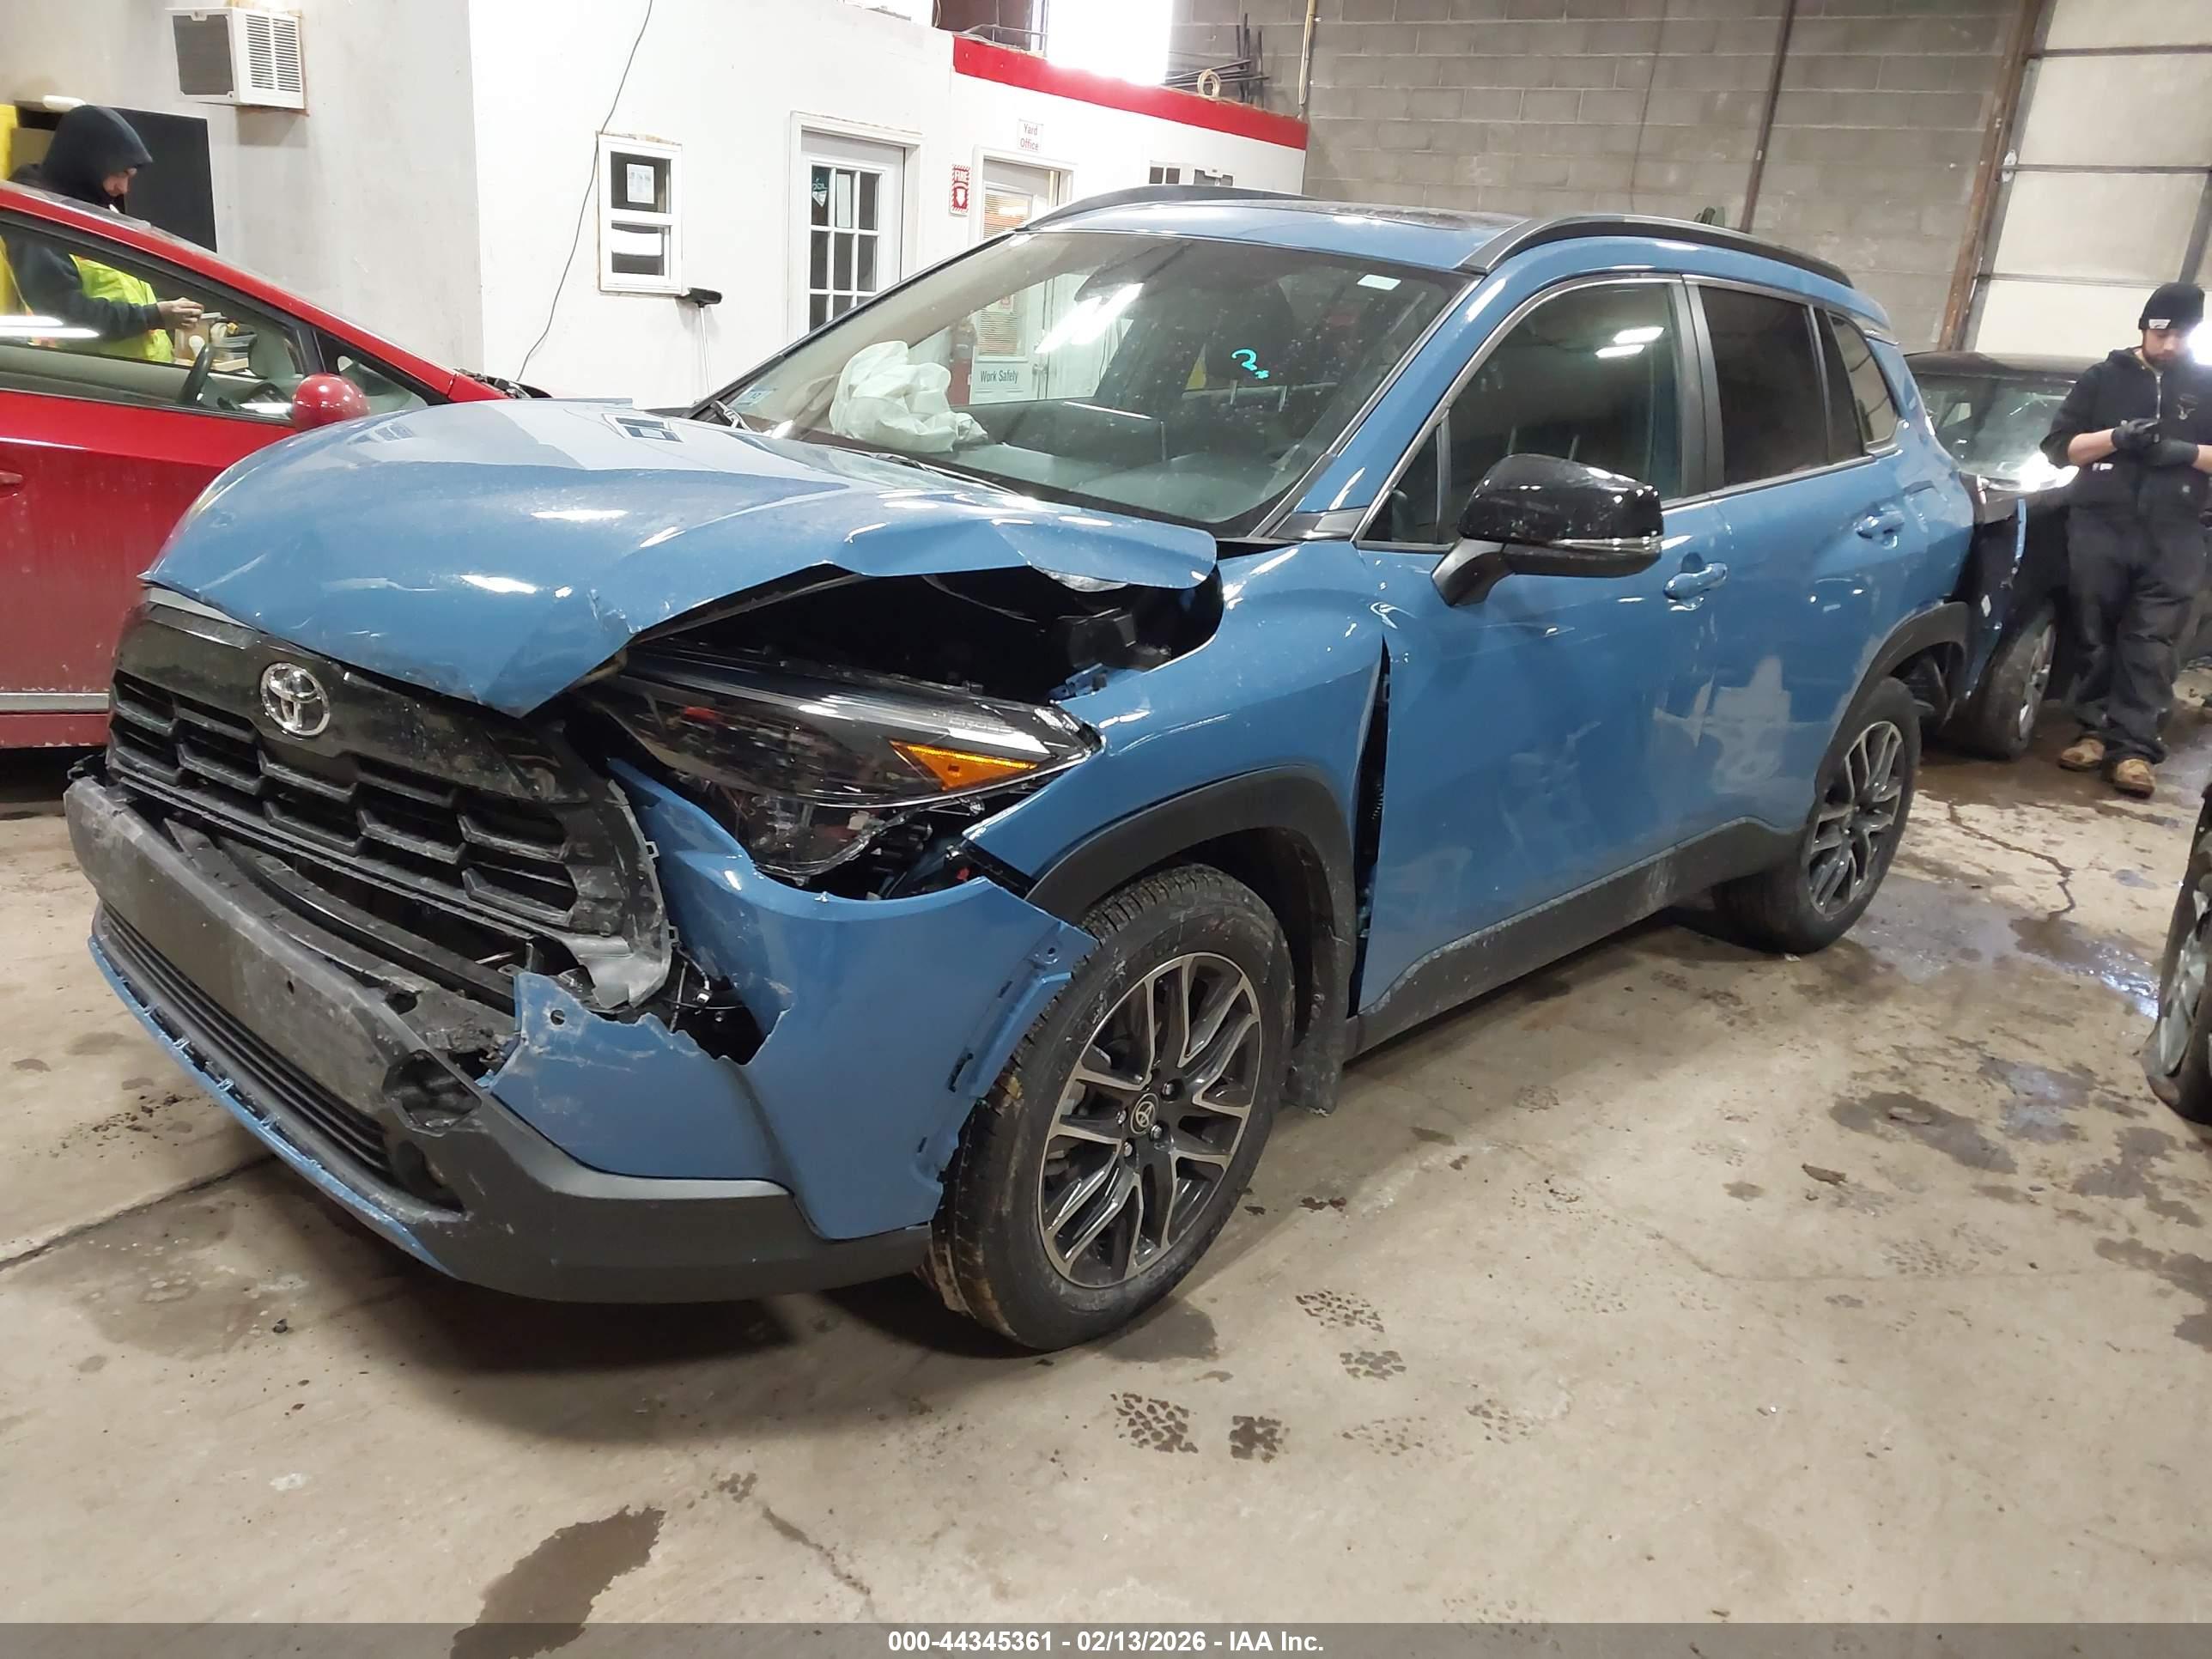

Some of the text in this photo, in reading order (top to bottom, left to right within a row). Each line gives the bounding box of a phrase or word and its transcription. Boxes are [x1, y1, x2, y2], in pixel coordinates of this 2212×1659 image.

[1024, 123, 1038, 136] Yard
[1019, 137, 1039, 151] Office
[981, 370, 997, 384] Work
